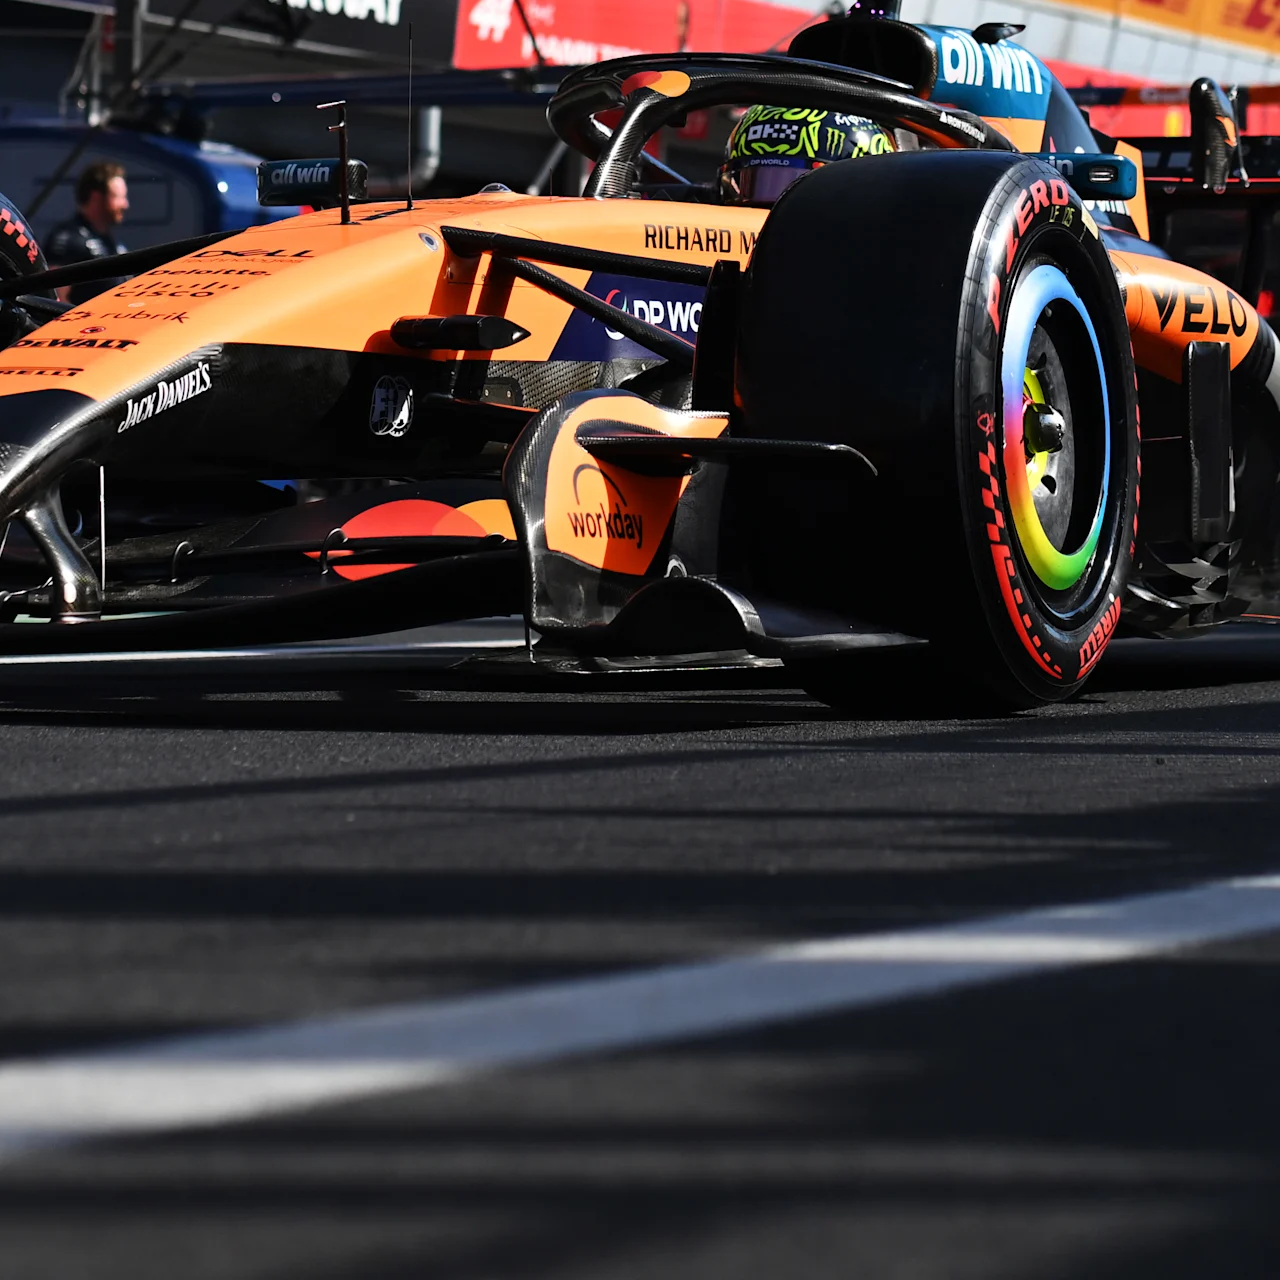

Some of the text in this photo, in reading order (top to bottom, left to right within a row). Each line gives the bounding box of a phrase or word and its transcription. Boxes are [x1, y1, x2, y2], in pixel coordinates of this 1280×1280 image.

[644, 224, 731, 254] RICHARD
[99, 310, 191, 324] rubrik
[632, 299, 665, 327] DP
[1150, 282, 1248, 337] VELO
[117, 391, 157, 433] JACK
[567, 502, 643, 549] workday
